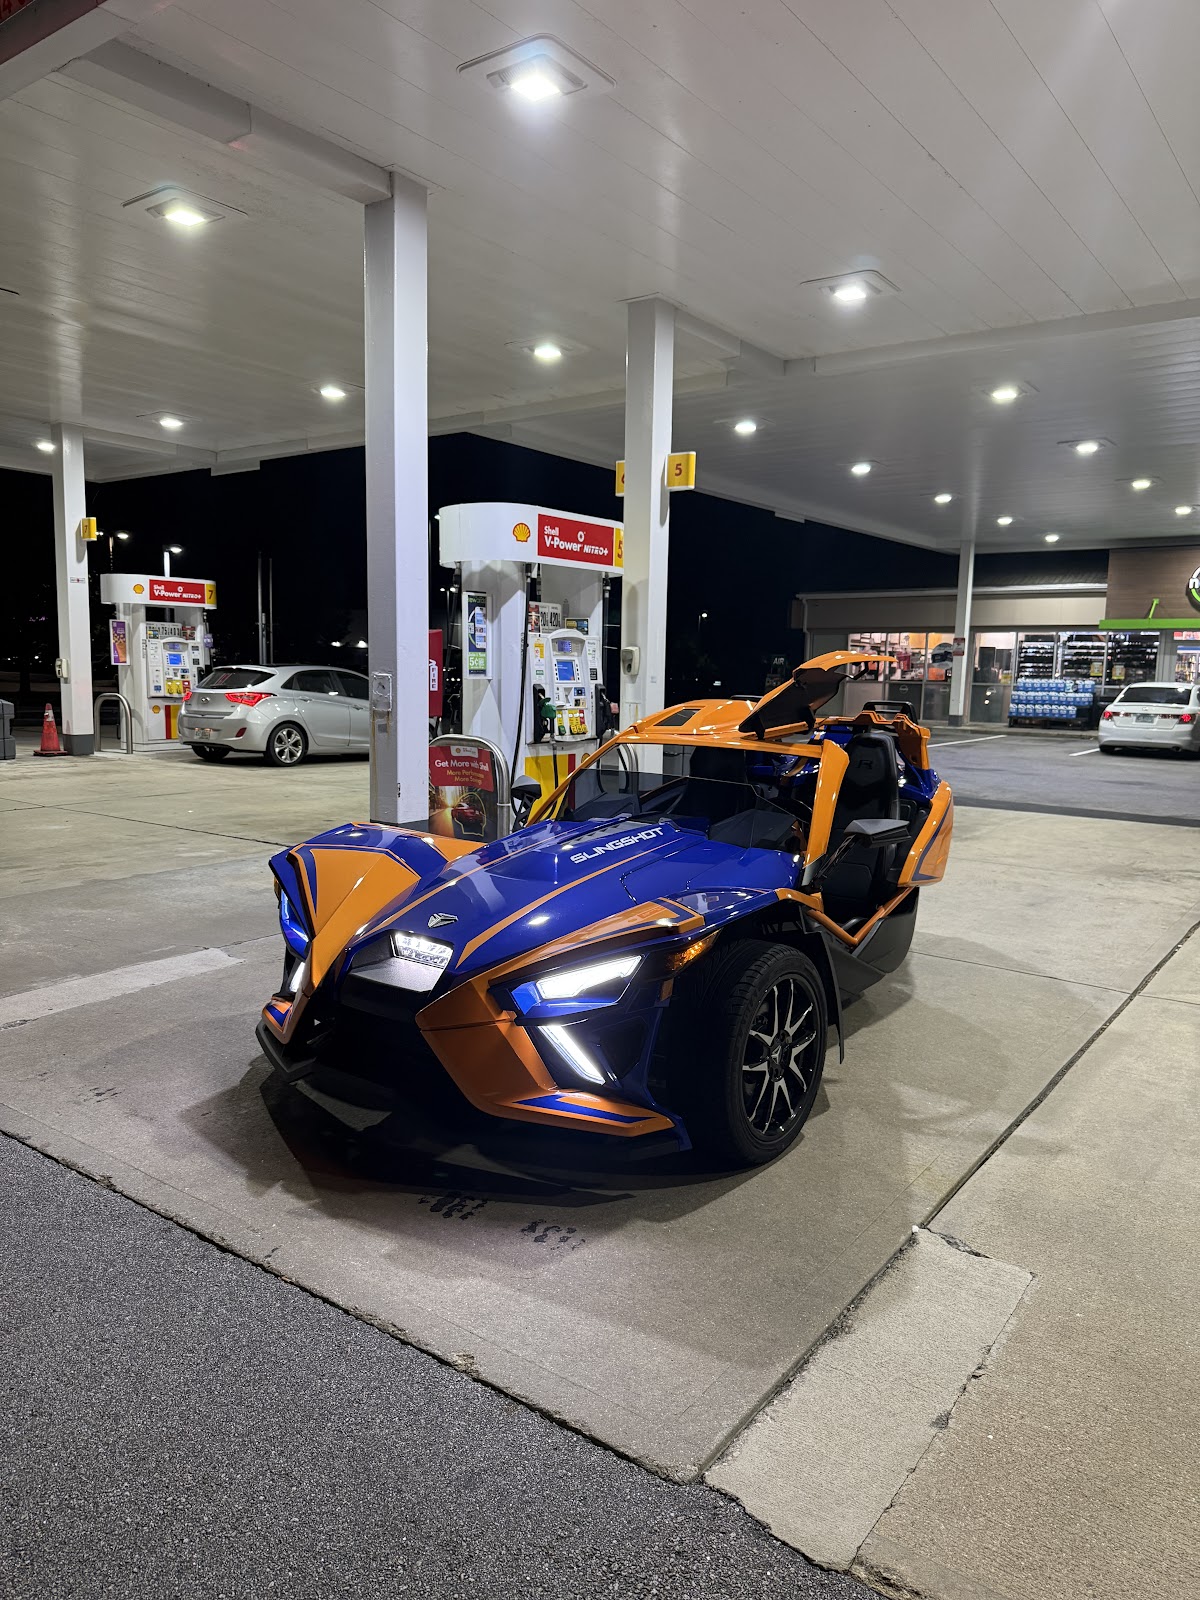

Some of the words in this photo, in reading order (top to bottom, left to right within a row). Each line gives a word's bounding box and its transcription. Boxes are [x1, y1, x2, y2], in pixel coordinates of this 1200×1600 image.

[674, 463, 682, 476] 5
[544, 526, 559, 536] Shell
[544, 535, 582, 552] V-Power
[617, 540, 623, 559] 5
[208, 590, 214, 599] 7
[435, 759, 449, 768] Get
[450, 759, 470, 768] More
[570, 827, 663, 864] SLINGSHOT
